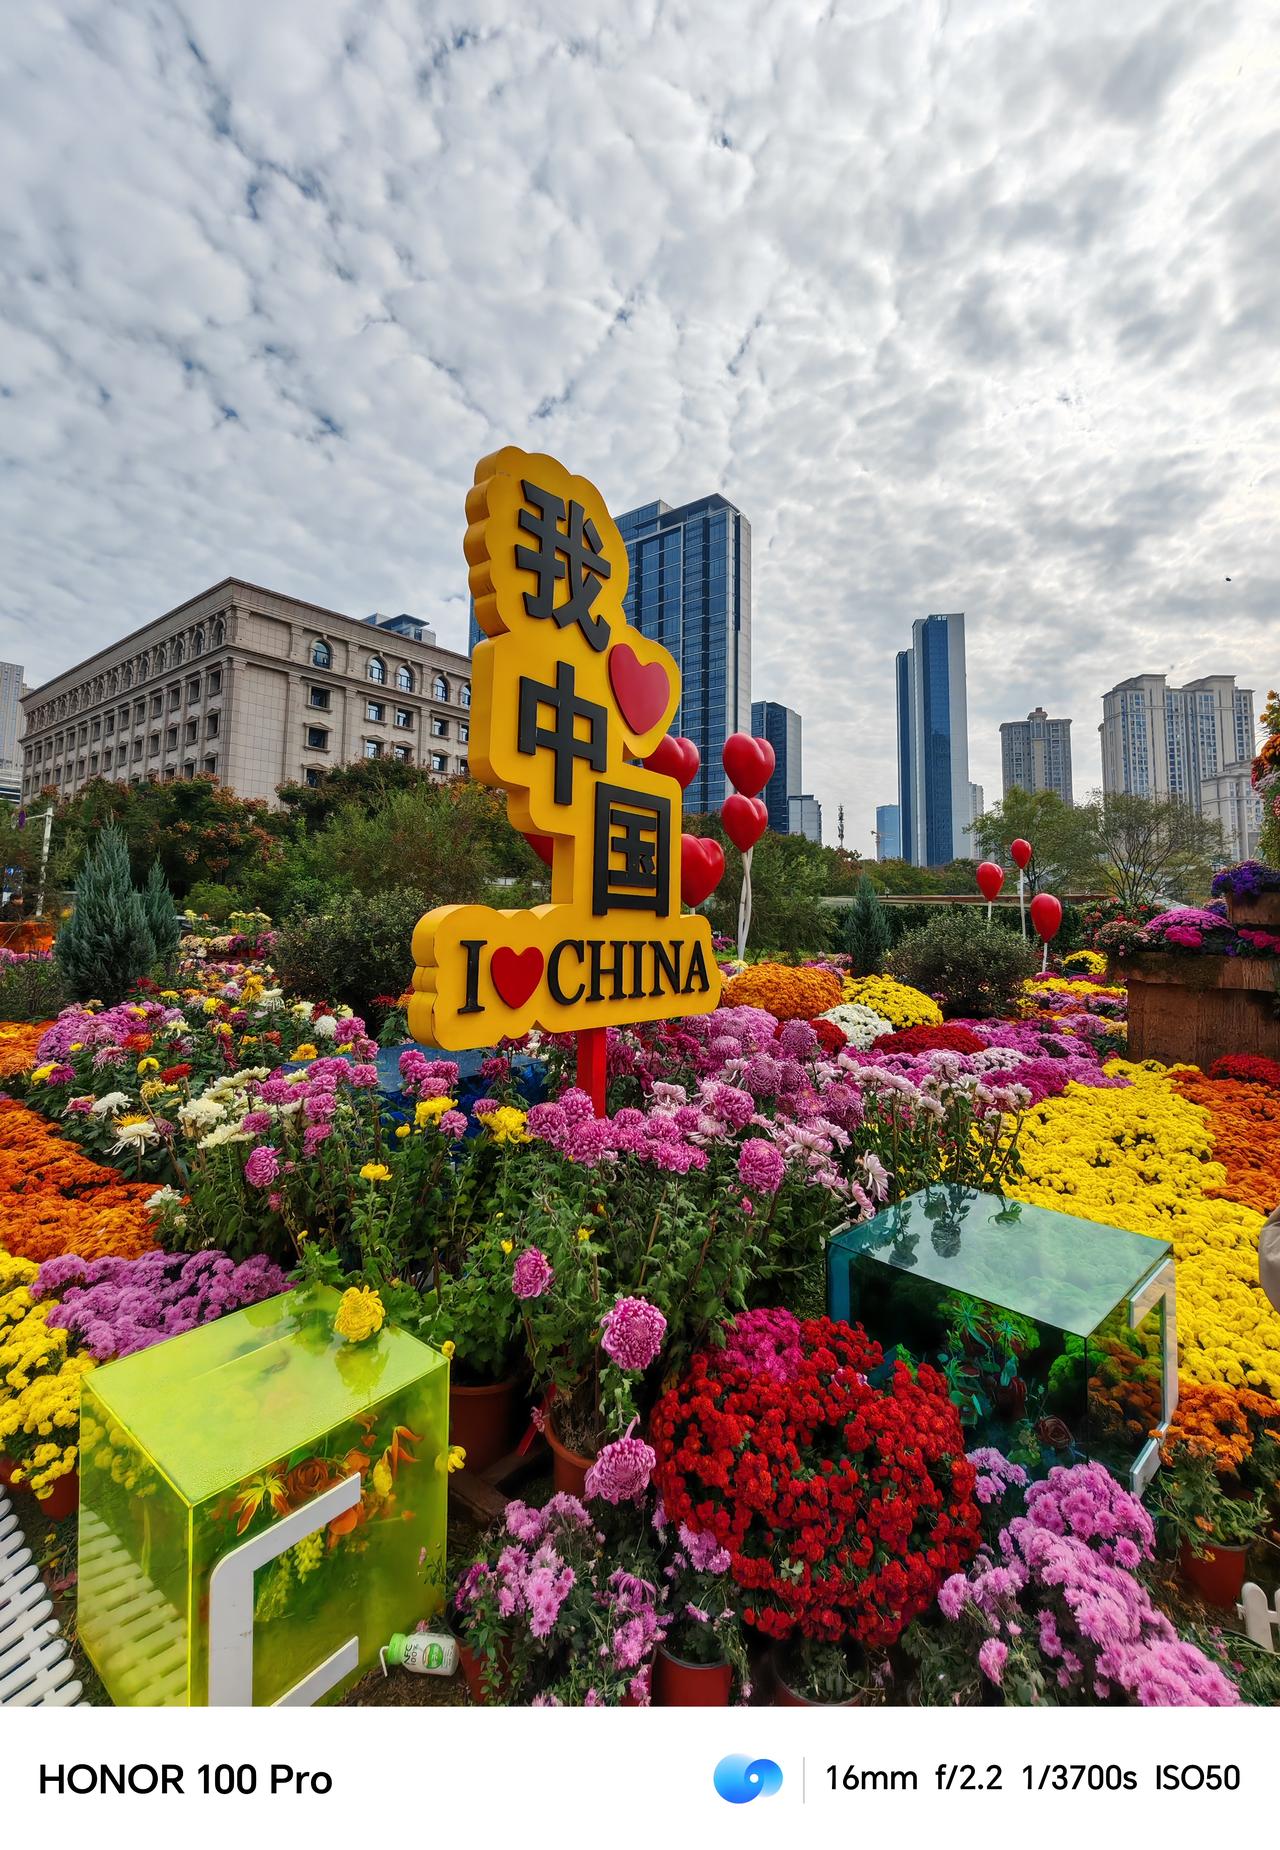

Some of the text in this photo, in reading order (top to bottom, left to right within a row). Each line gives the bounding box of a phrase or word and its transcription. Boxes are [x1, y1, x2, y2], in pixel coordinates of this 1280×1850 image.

[514, 479, 611, 652] 我
[457, 939, 711, 1014] I CHINA
[404, 1644, 413, 1665] NFC
